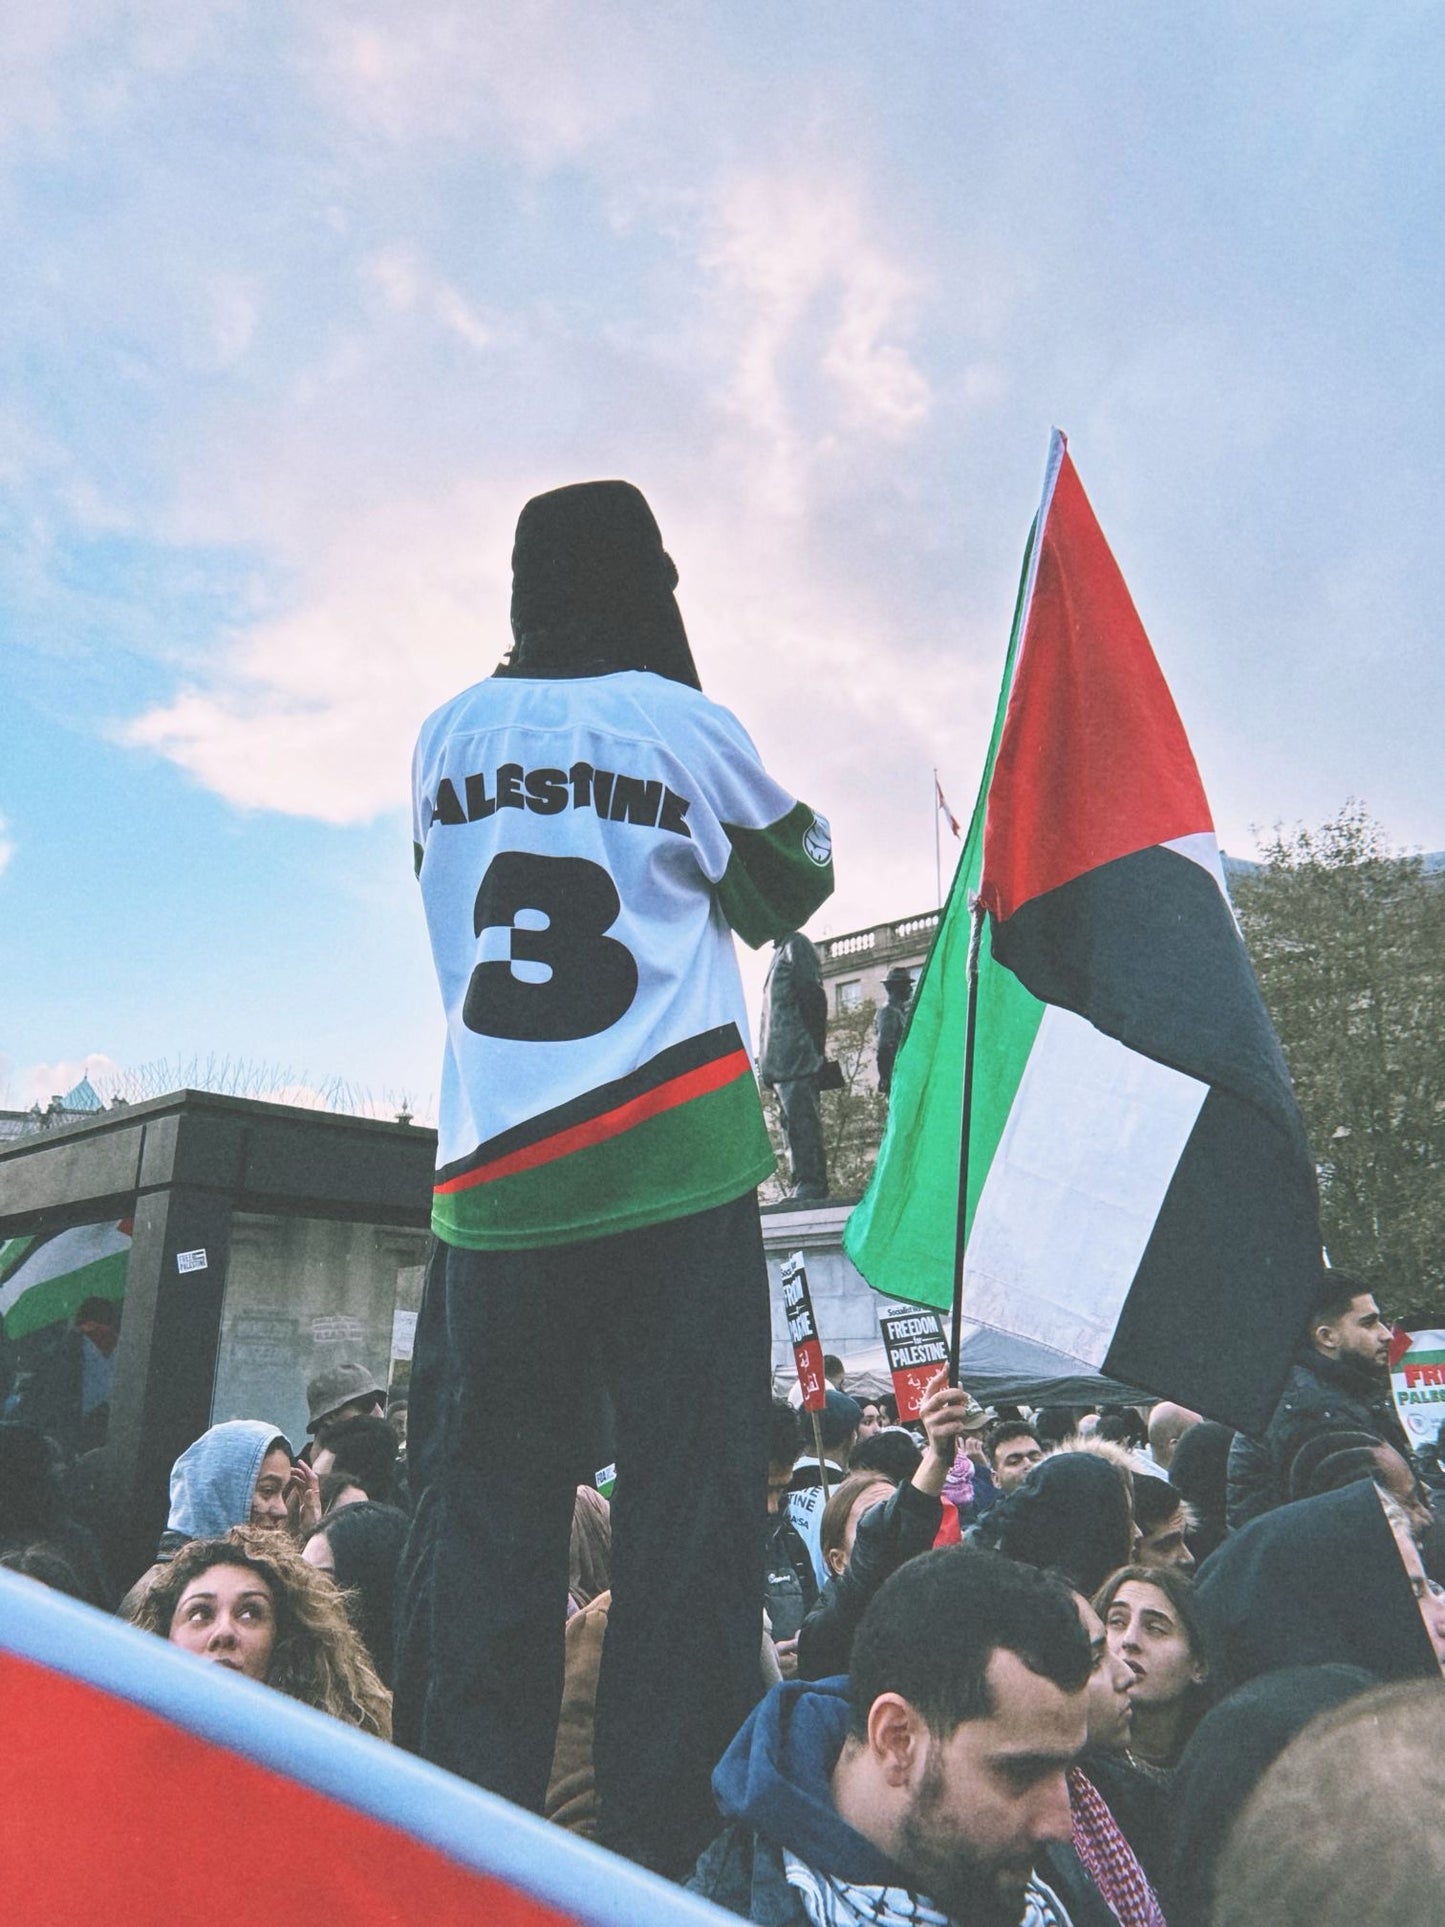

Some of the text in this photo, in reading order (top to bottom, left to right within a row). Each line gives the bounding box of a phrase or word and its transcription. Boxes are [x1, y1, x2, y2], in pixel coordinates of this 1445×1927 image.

[462, 851, 639, 1042] 3
[887, 1316, 939, 1340] FREEDOM
[913, 1336, 922, 1346] for
[890, 1342, 948, 1368] PALESTINE
